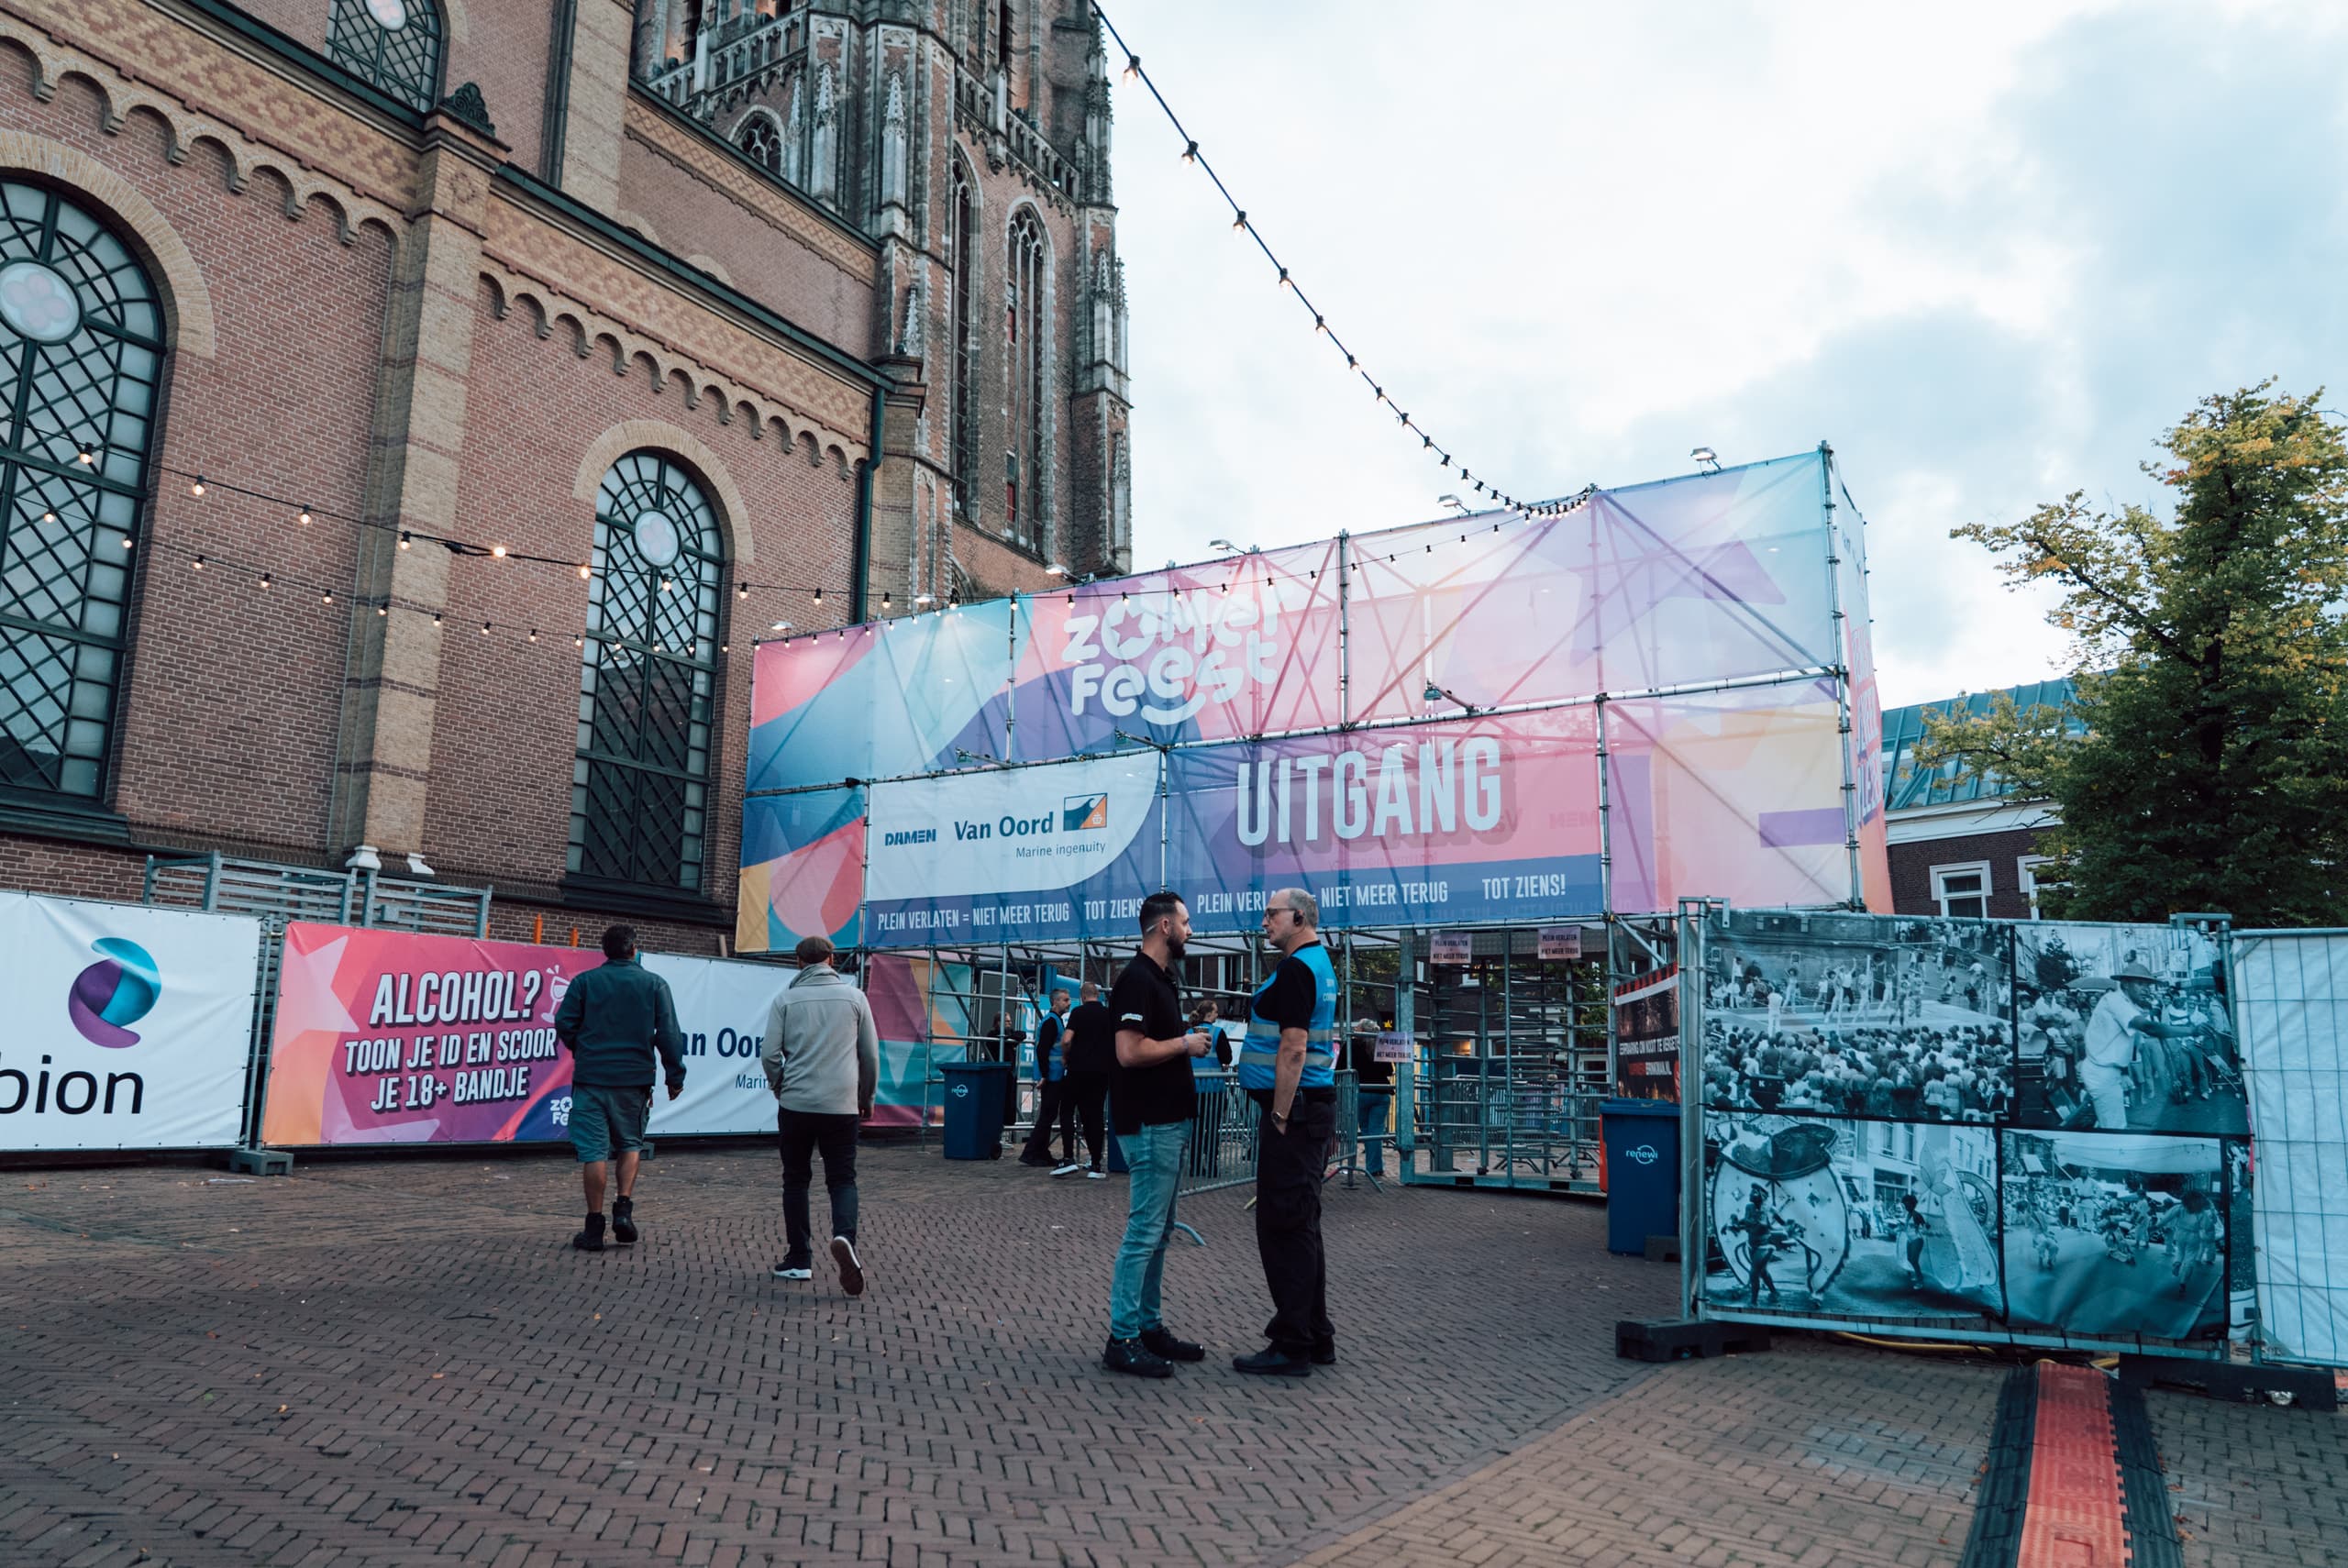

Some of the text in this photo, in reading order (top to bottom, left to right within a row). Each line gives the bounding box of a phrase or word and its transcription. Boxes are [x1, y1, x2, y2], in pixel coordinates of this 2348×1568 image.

[1237, 736, 1501, 846] UITGANG
[884, 812, 1054, 846] DAMEN Van Oord
[1015, 841, 1106, 859] Marine ingenuity
[1197, 891, 1233, 914] PLEIN
[1321, 886, 1351, 908] NIET
[1356, 883, 1397, 906] MEER
[1401, 880, 1449, 904] TERUG
[1482, 877, 1511, 900] TOT
[1515, 874, 1566, 899] ZIENS!
[878, 911, 906, 931] PLEIN
[908, 909, 959, 929] VERLATEN
[972, 906, 996, 926] NIET
[1000, 904, 1032, 925] MEER
[1035, 902, 1069, 923] TERUG
[1084, 900, 1106, 921] TOT
[1110, 898, 1145, 920] ZIENS
[369, 969, 542, 1026] ALCOHOL?
[345, 1028, 558, 1074] TOON JE ID EN SCOOR
[717, 1027, 765, 1058] Oor
[371, 1066, 529, 1110] JE 18+ BANDJE
[1625, 1148, 1658, 1161] renewi
